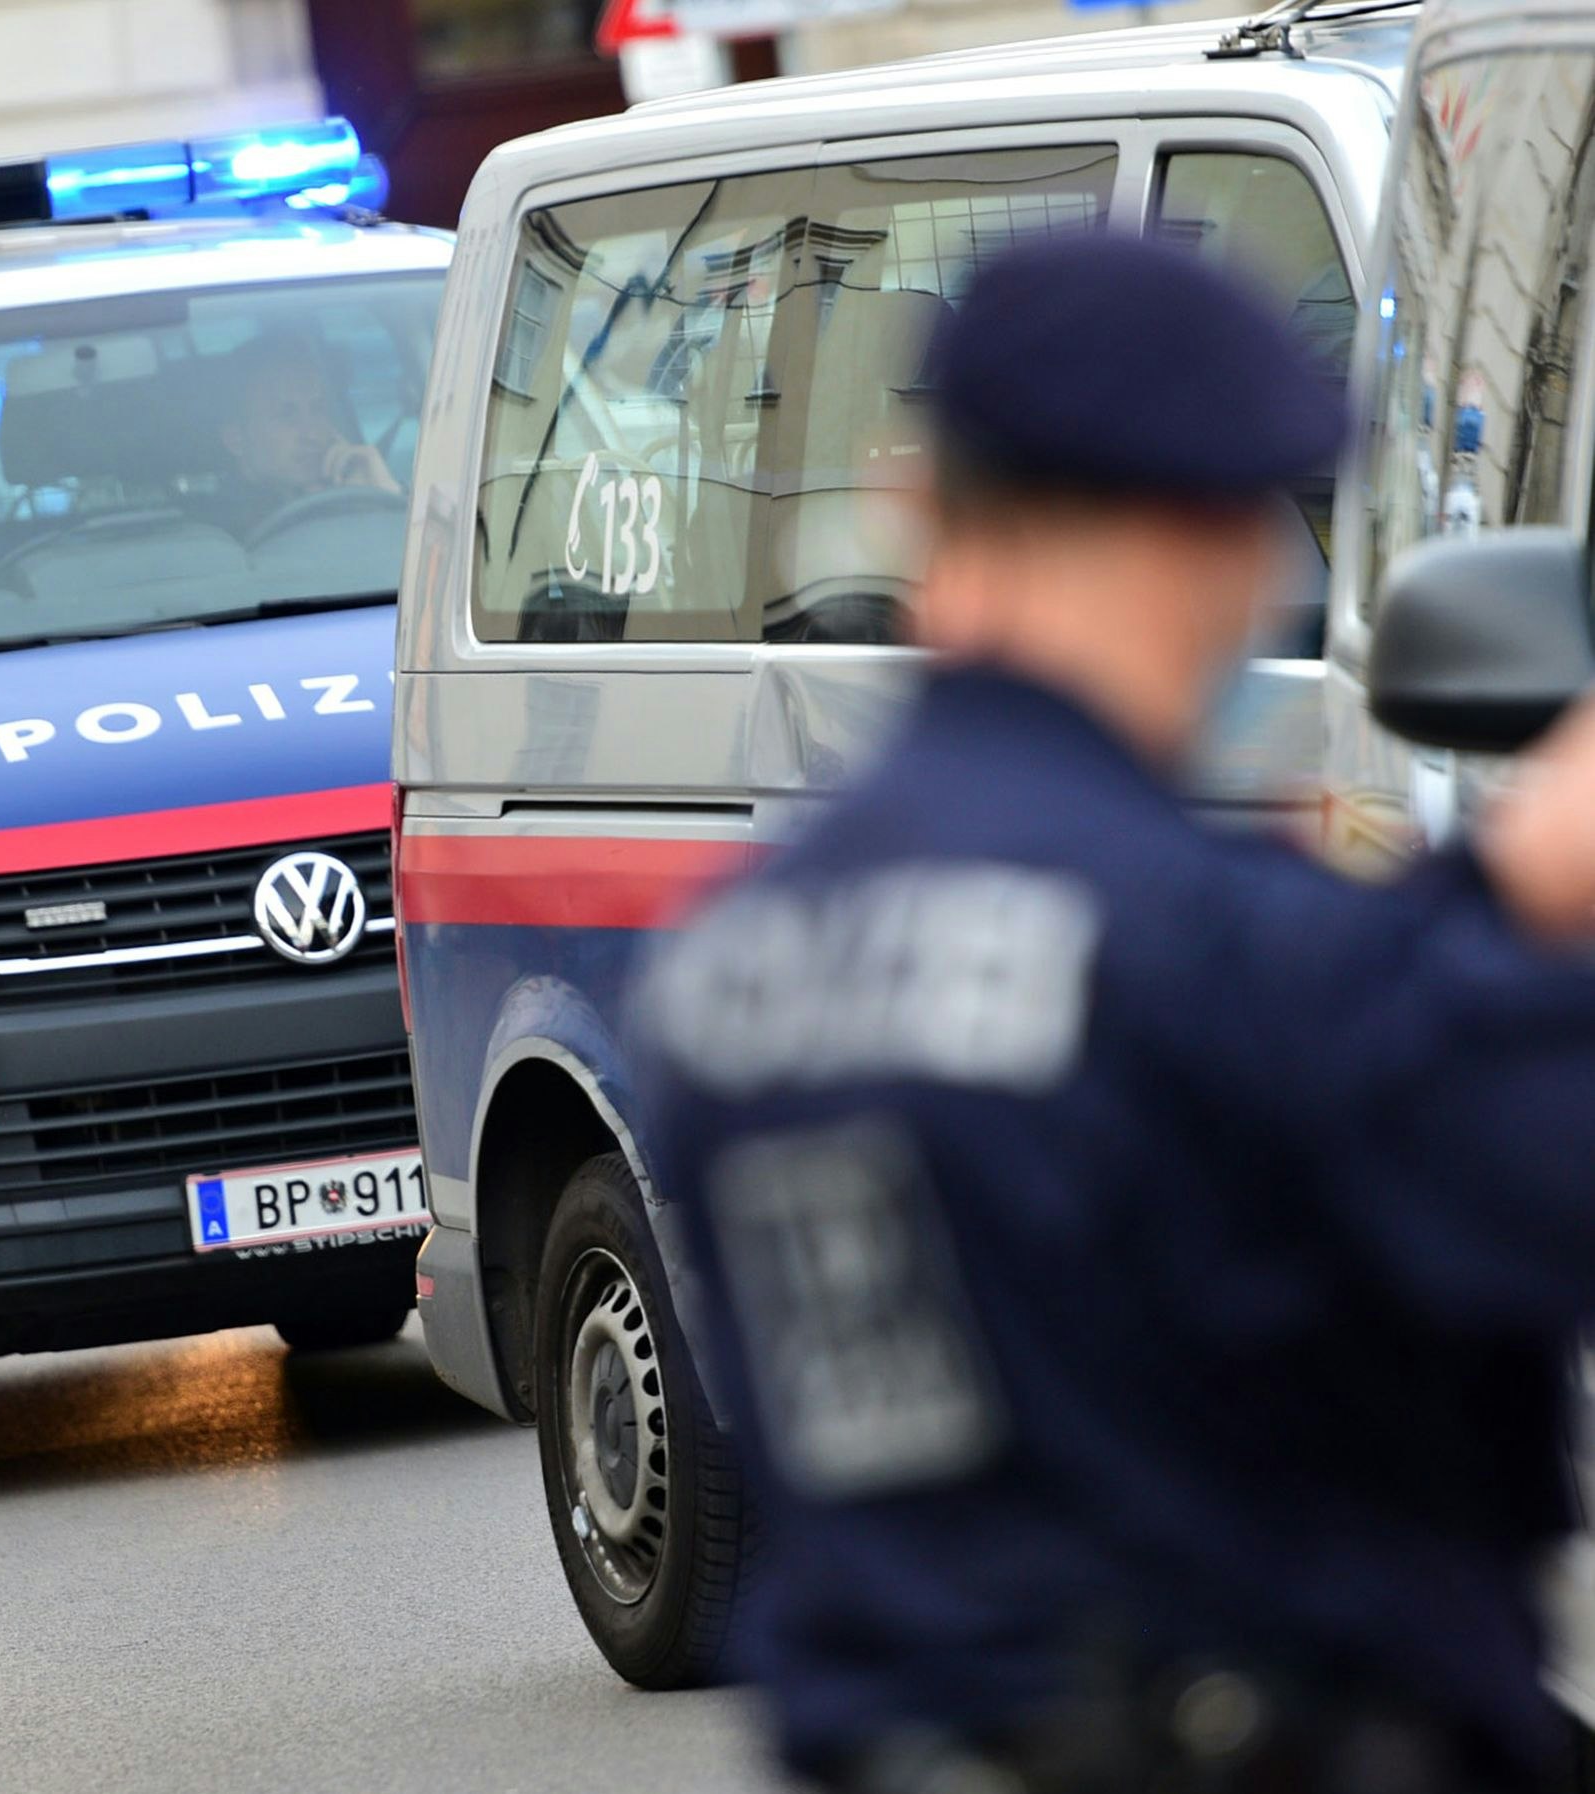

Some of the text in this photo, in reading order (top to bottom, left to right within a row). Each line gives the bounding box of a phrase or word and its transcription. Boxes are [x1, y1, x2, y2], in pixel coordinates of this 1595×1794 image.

[600, 474, 662, 593] 133
[207, 1164, 427, 1237] A BP 911
